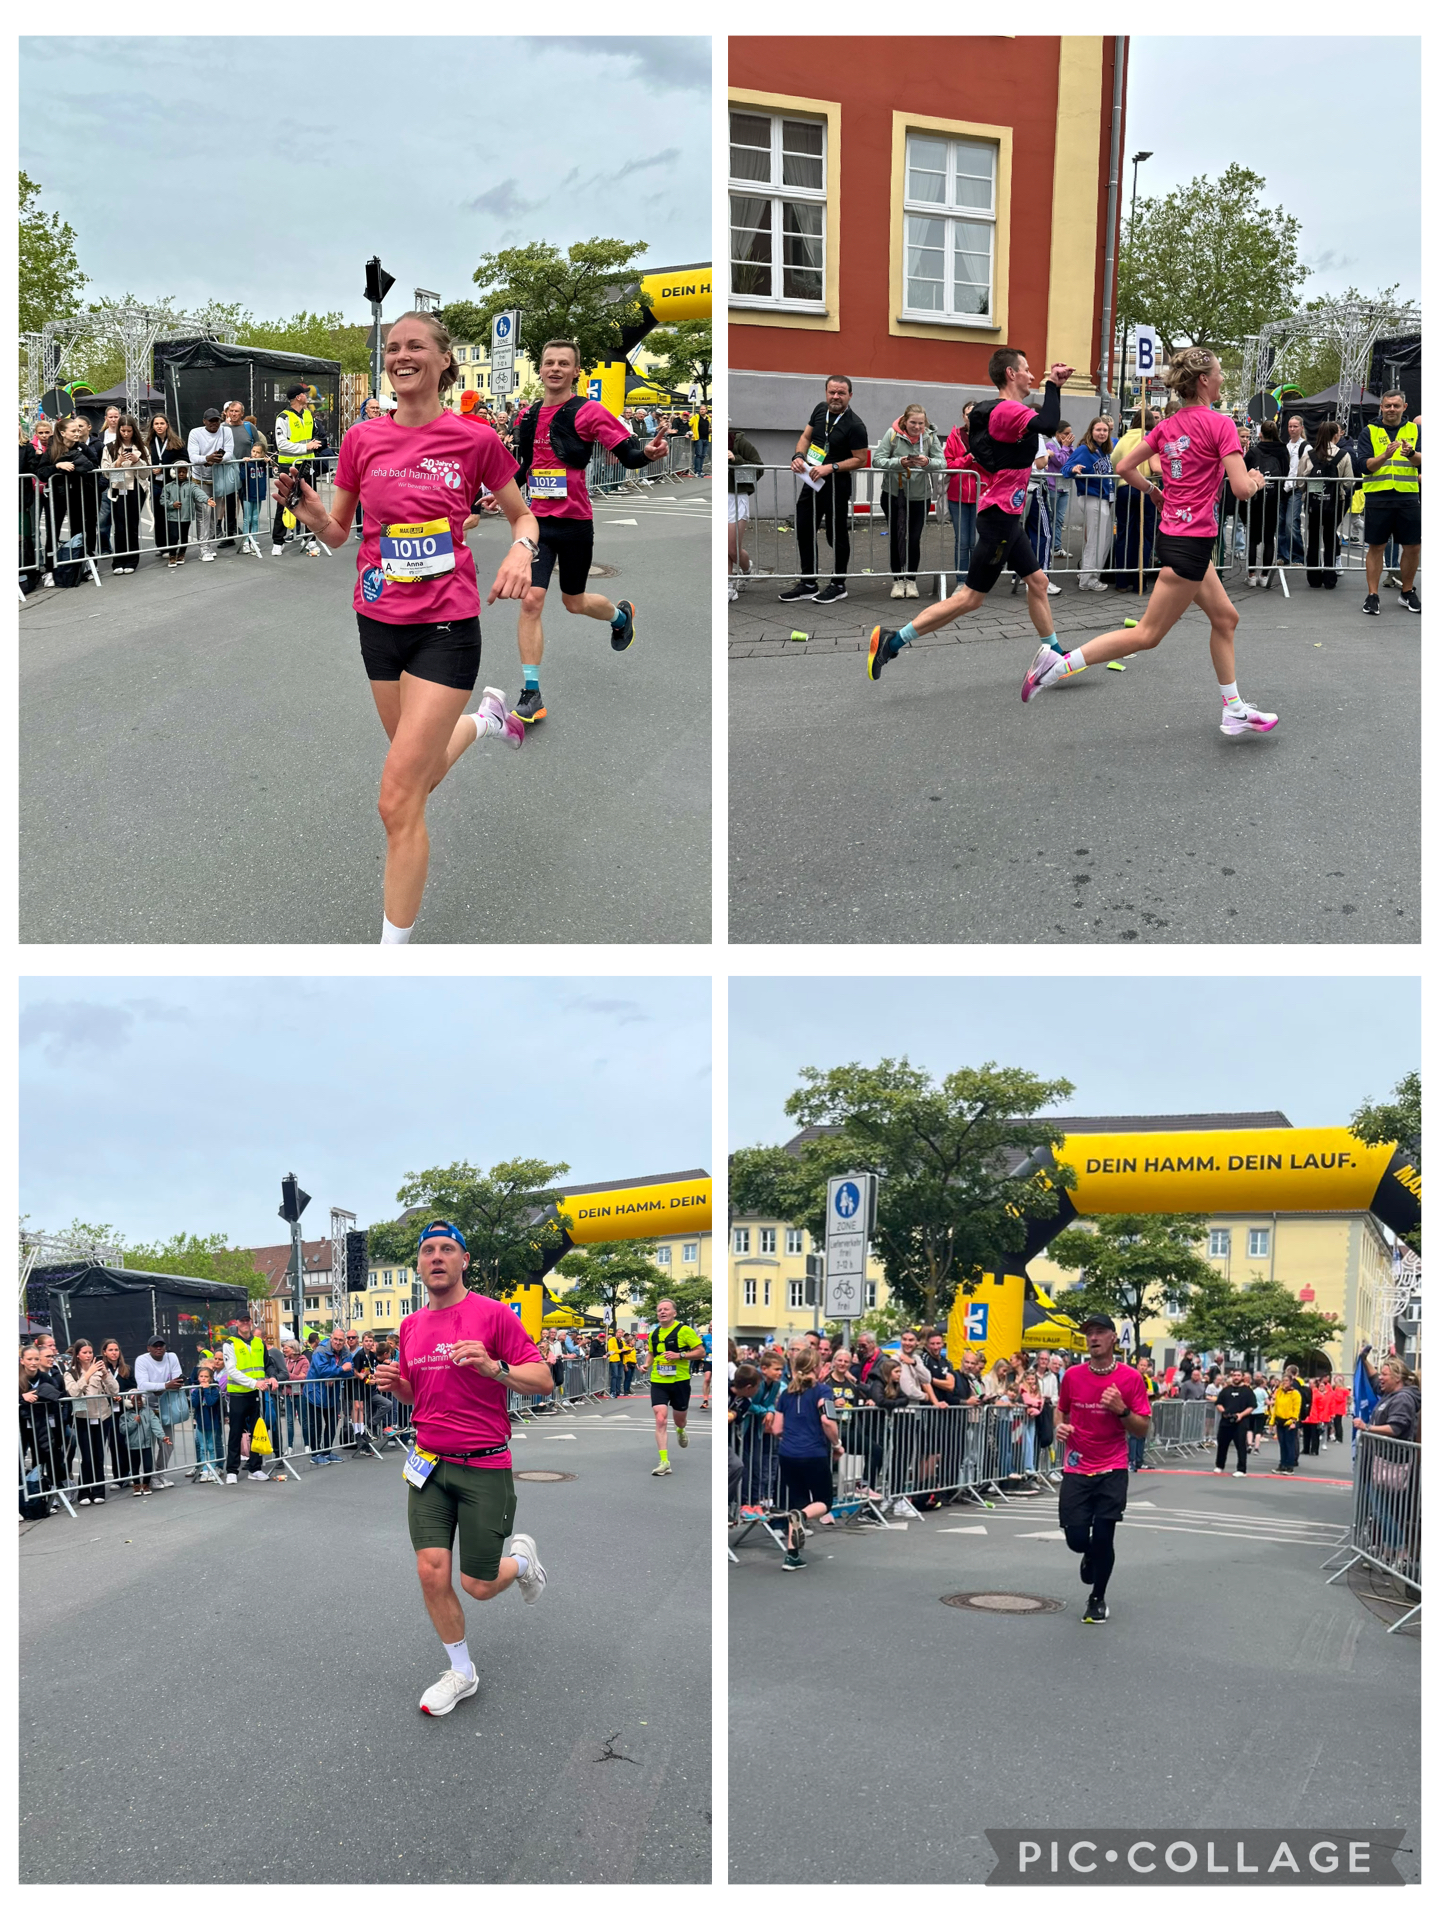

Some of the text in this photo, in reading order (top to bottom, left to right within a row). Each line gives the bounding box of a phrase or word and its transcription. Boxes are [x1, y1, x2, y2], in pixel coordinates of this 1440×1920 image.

[661, 283, 712, 298] DEIN H
[1138, 337, 1154, 370] B
[689, 389, 697, 400] A
[422, 457, 453, 468] 20 Jahre
[371, 467, 440, 481] reha bad hamm
[534, 476, 558, 487] 1012
[391, 537, 437, 558] 1010
[385, 562, 393, 572] A
[1086, 1151, 1357, 1174] DEIN HAMM. DEIN LAUF.
[578, 1194, 707, 1220] DEIN HAMM. DEIN
[836, 1220, 857, 1232] ZONE
[837, 1301, 850, 1311] frei
[603, 1311, 611, 1321] A
[1042, 1336, 1061, 1344] LAUF
[1121, 1328, 1130, 1345] A
[436, 1343, 446, 1351] 20
[413, 1355, 426, 1365] bad
[427, 1354, 449, 1363] hamm
